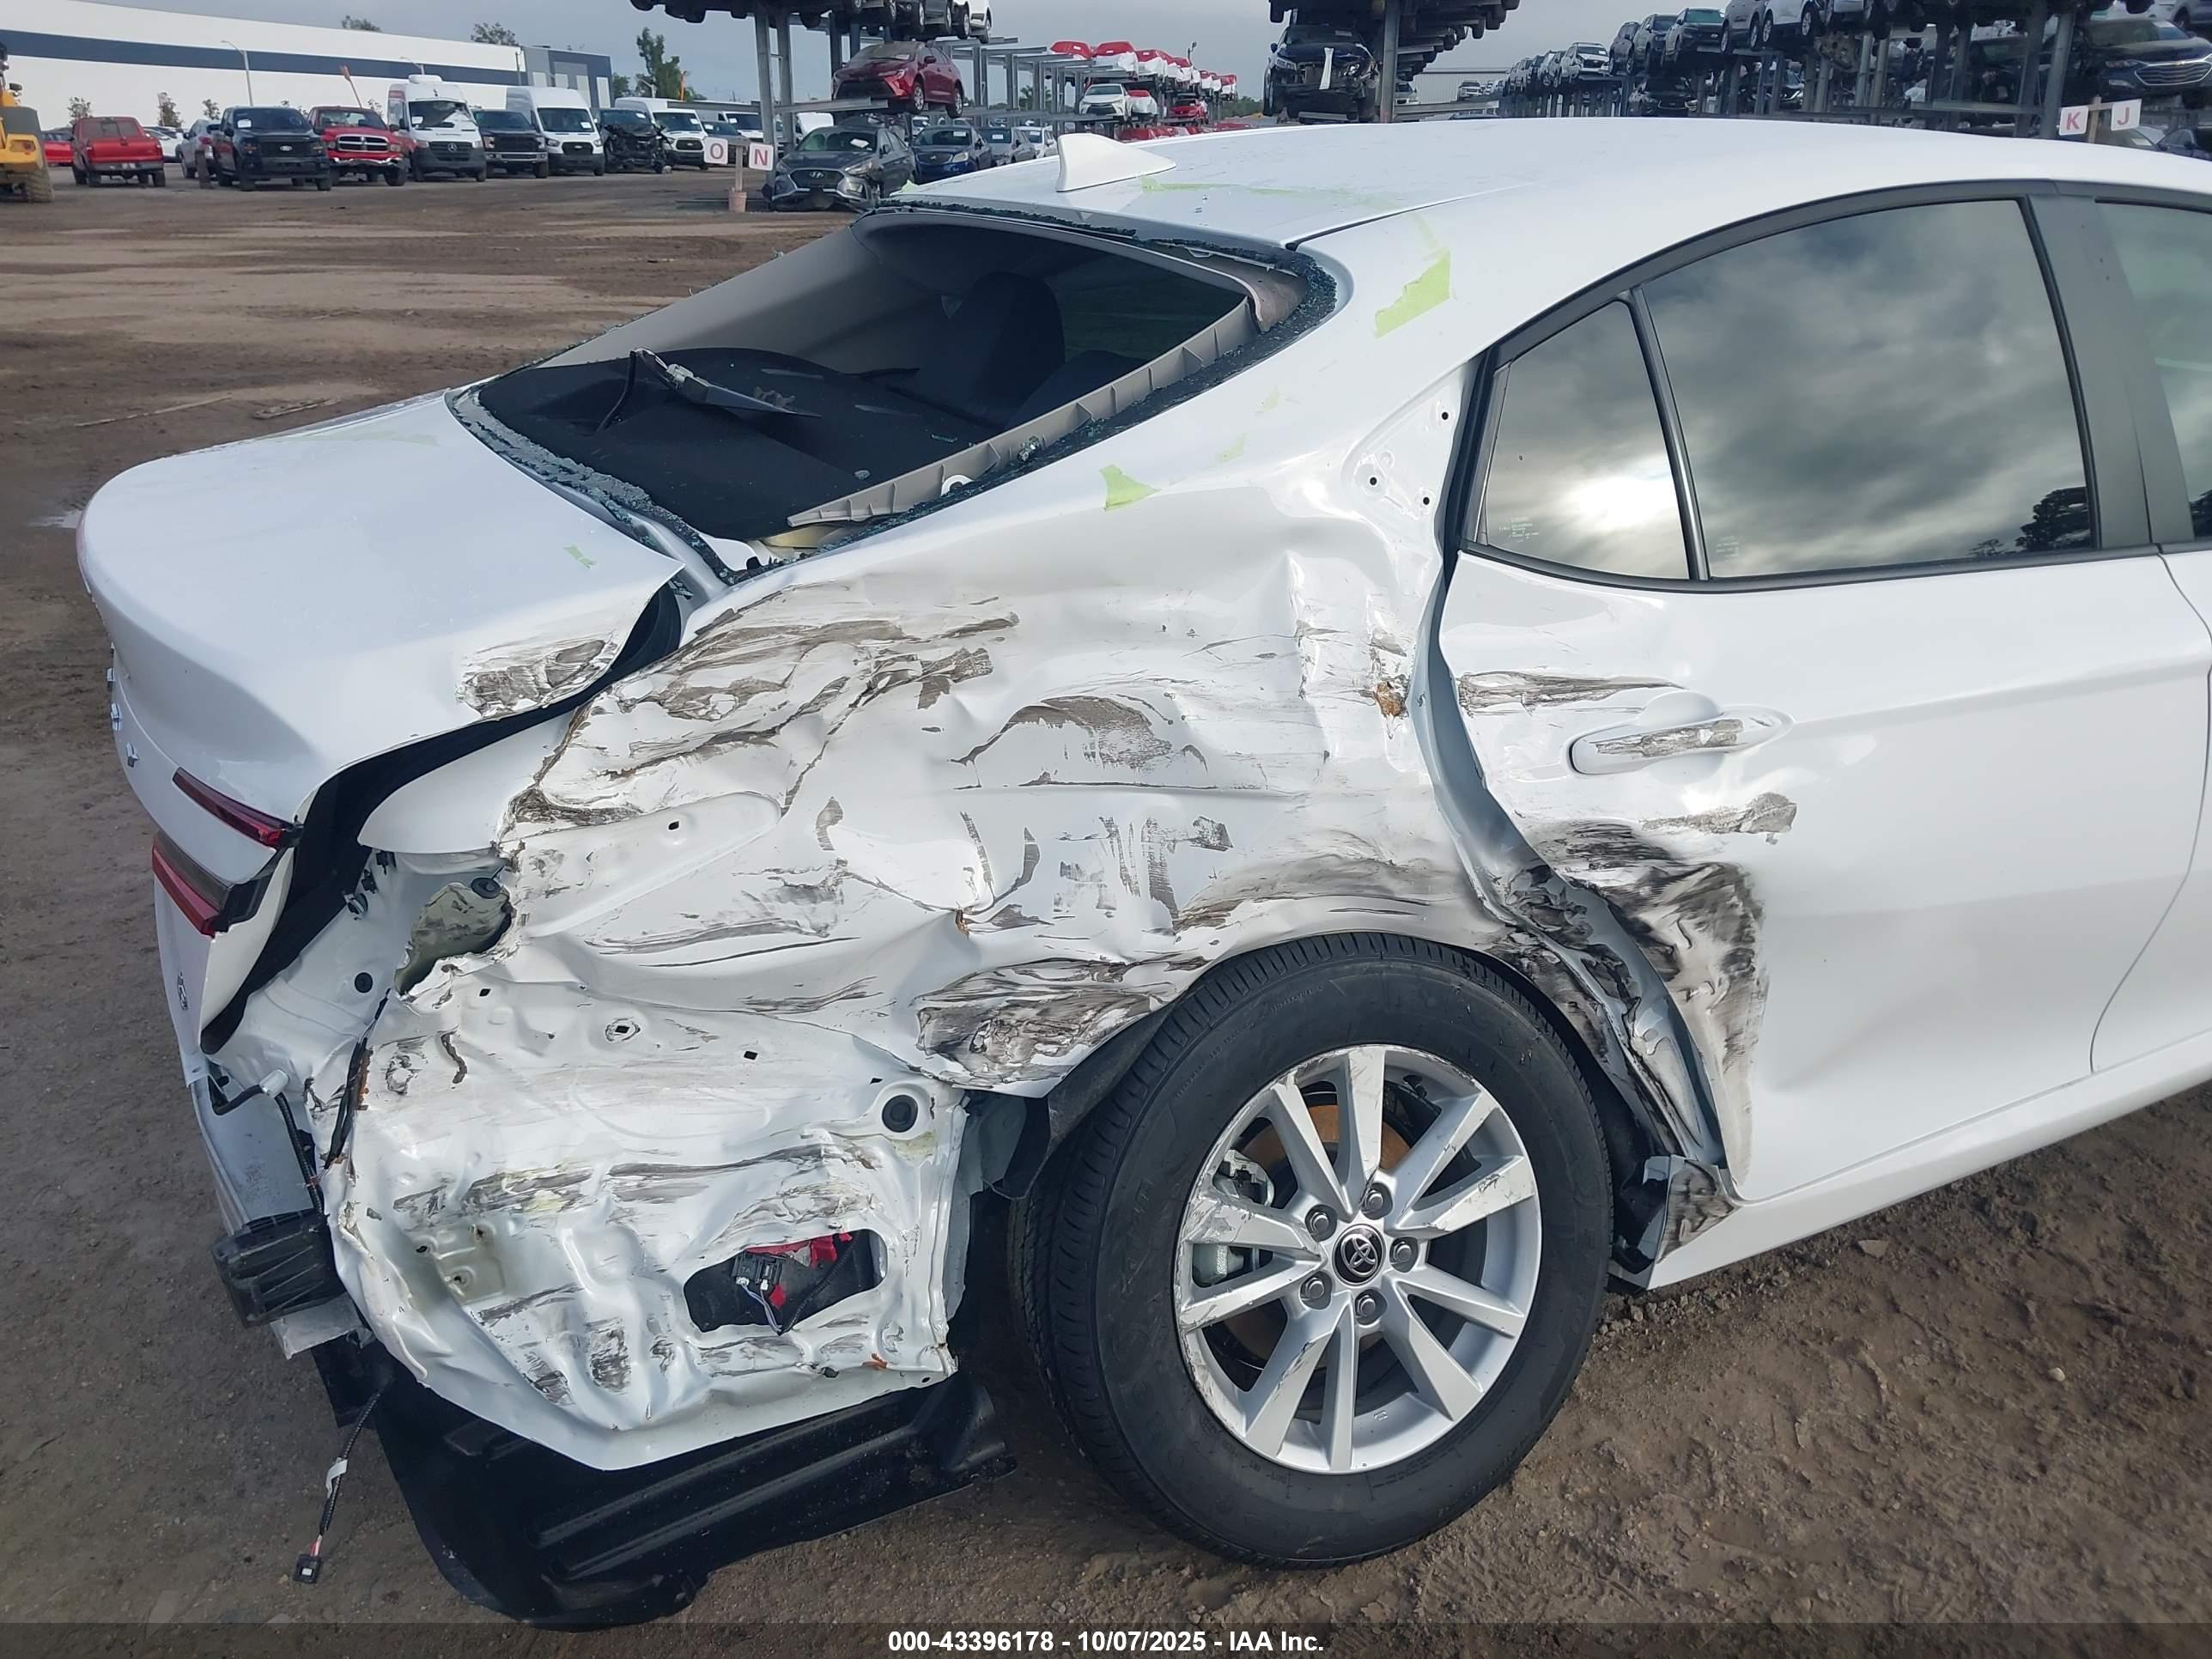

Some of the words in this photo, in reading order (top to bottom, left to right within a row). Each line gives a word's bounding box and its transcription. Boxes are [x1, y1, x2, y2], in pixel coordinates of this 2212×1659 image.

[2066, 111, 2081, 131] K
[2117, 106, 2130, 125] J
[709, 143, 724, 160] O
[754, 149, 769, 166] N
